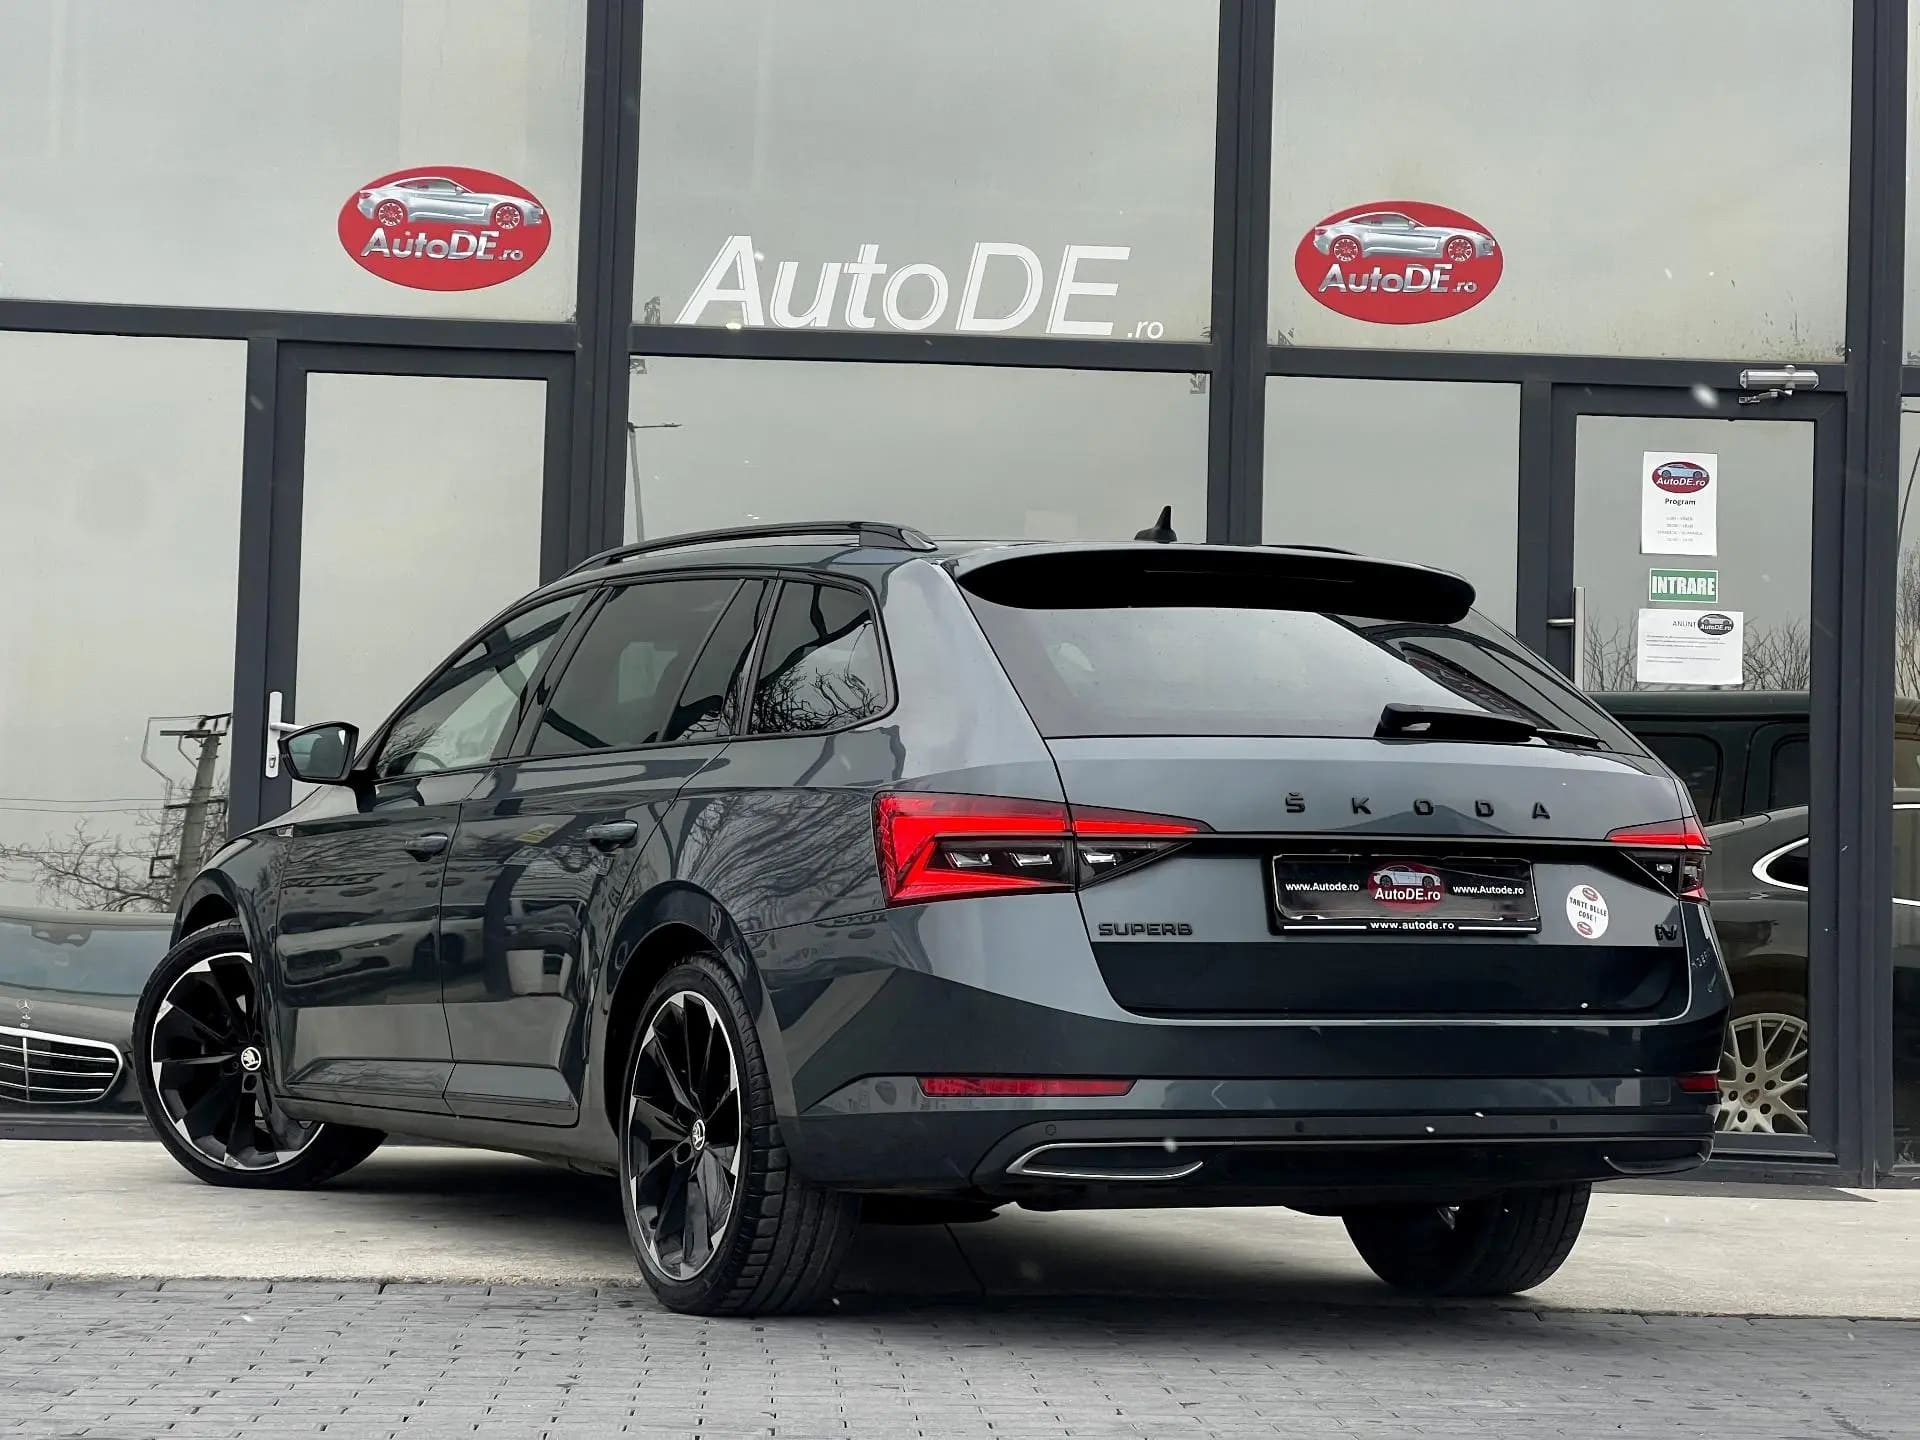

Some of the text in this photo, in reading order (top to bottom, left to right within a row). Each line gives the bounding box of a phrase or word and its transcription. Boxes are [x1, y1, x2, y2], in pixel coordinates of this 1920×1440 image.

[360, 227, 524, 261] AutoDE.ro
[1318, 263, 1478, 295] AutoDE.ro
[1656, 476, 1706, 487] AutoDE.ro
[1664, 498, 1696, 507] Program
[1651, 575, 1716, 596] INTRARE
[1700, 623, 1732, 632] AutoDE.ro
[1284, 792, 1551, 820] ŠKODA
[1285, 882, 1360, 892] www.Autode.ro
[1374, 887, 1441, 901] AutoDE.ro
[1452, 885, 1525, 895] www.Autode.ro
[1569, 896, 1588, 910] TANTE
[1098, 922, 1193, 936] SUPERB
[1370, 921, 1455, 930] www.autode.ro
